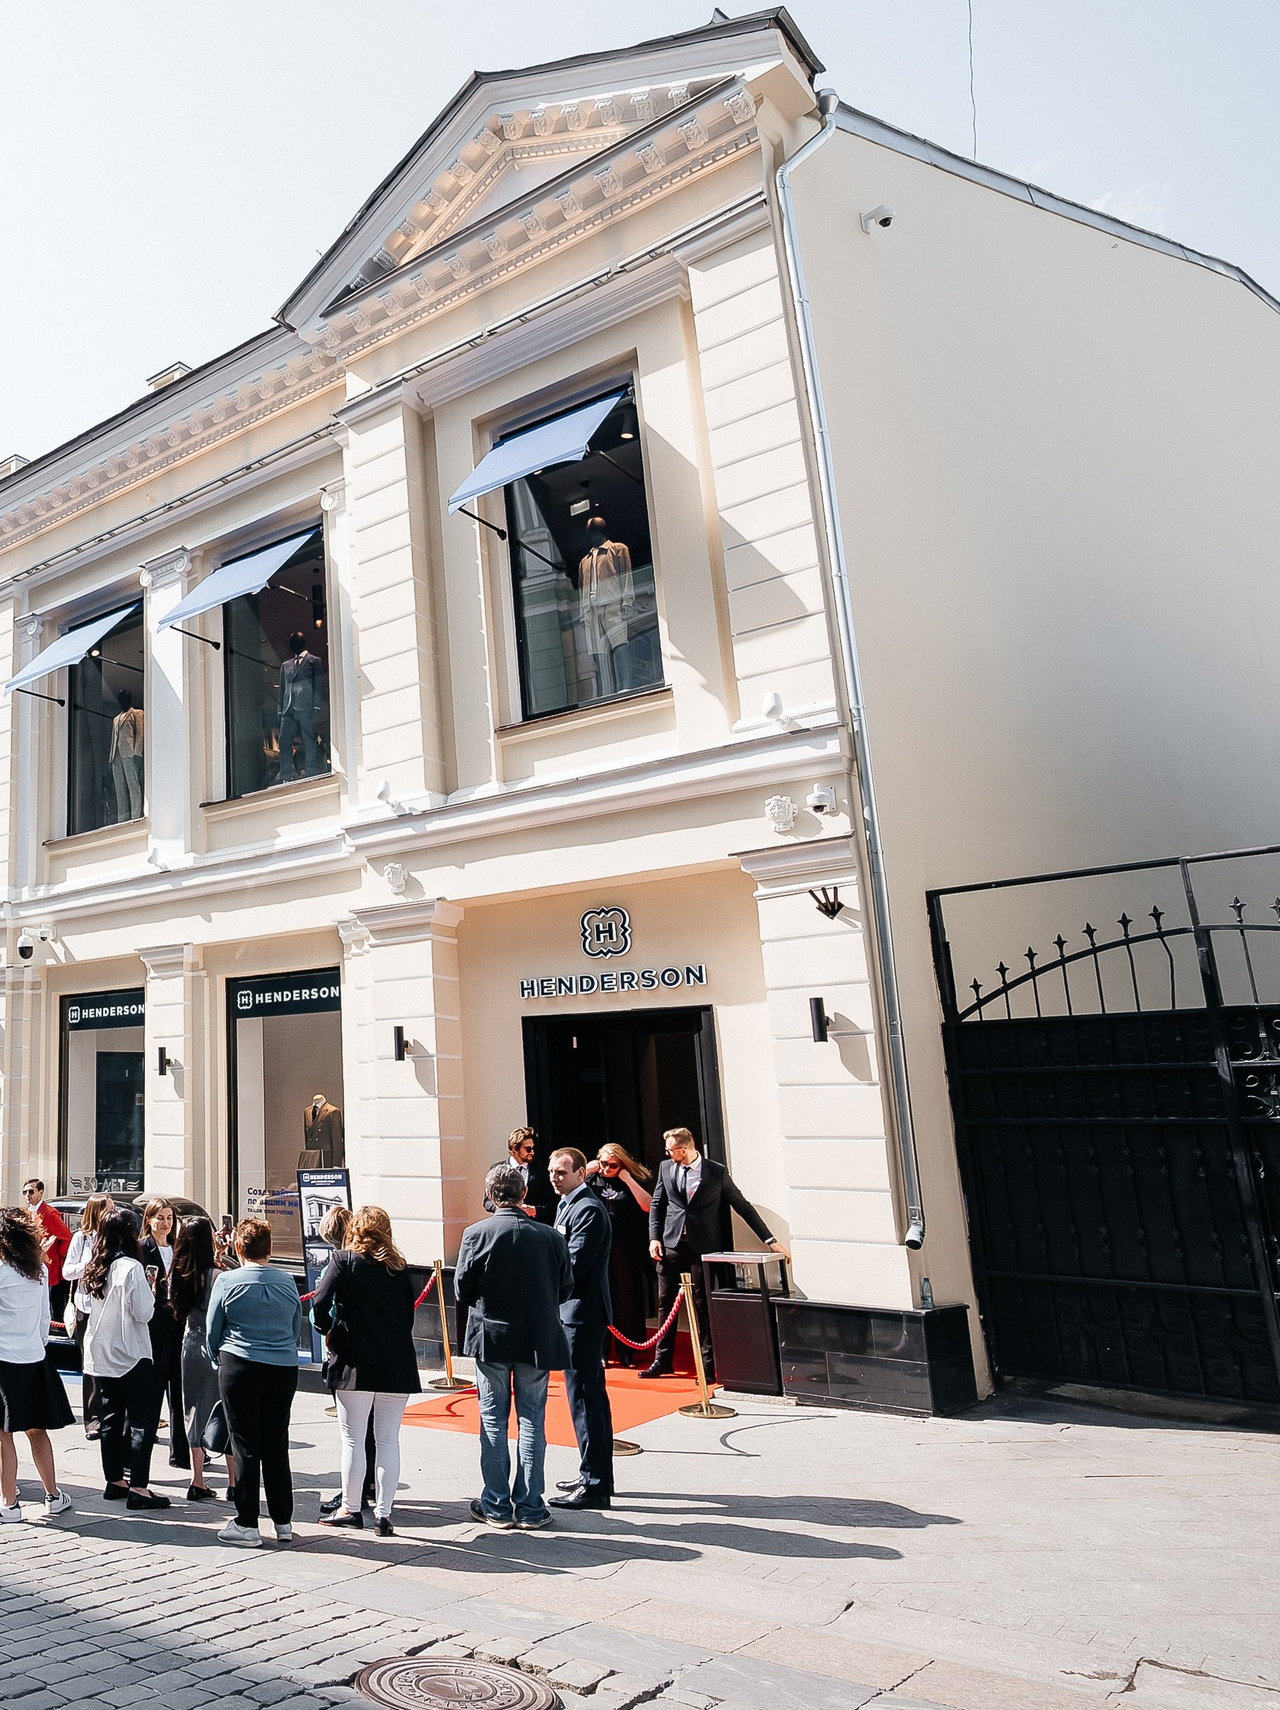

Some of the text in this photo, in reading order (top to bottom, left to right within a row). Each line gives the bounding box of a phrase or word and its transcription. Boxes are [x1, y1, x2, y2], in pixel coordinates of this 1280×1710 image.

[520, 964, 708, 999] HENDERSON
[255, 986, 340, 1004] HENDERSON
[82, 1004, 145, 1019] HENDERSON
[84, 1177, 98, 1191] 30
